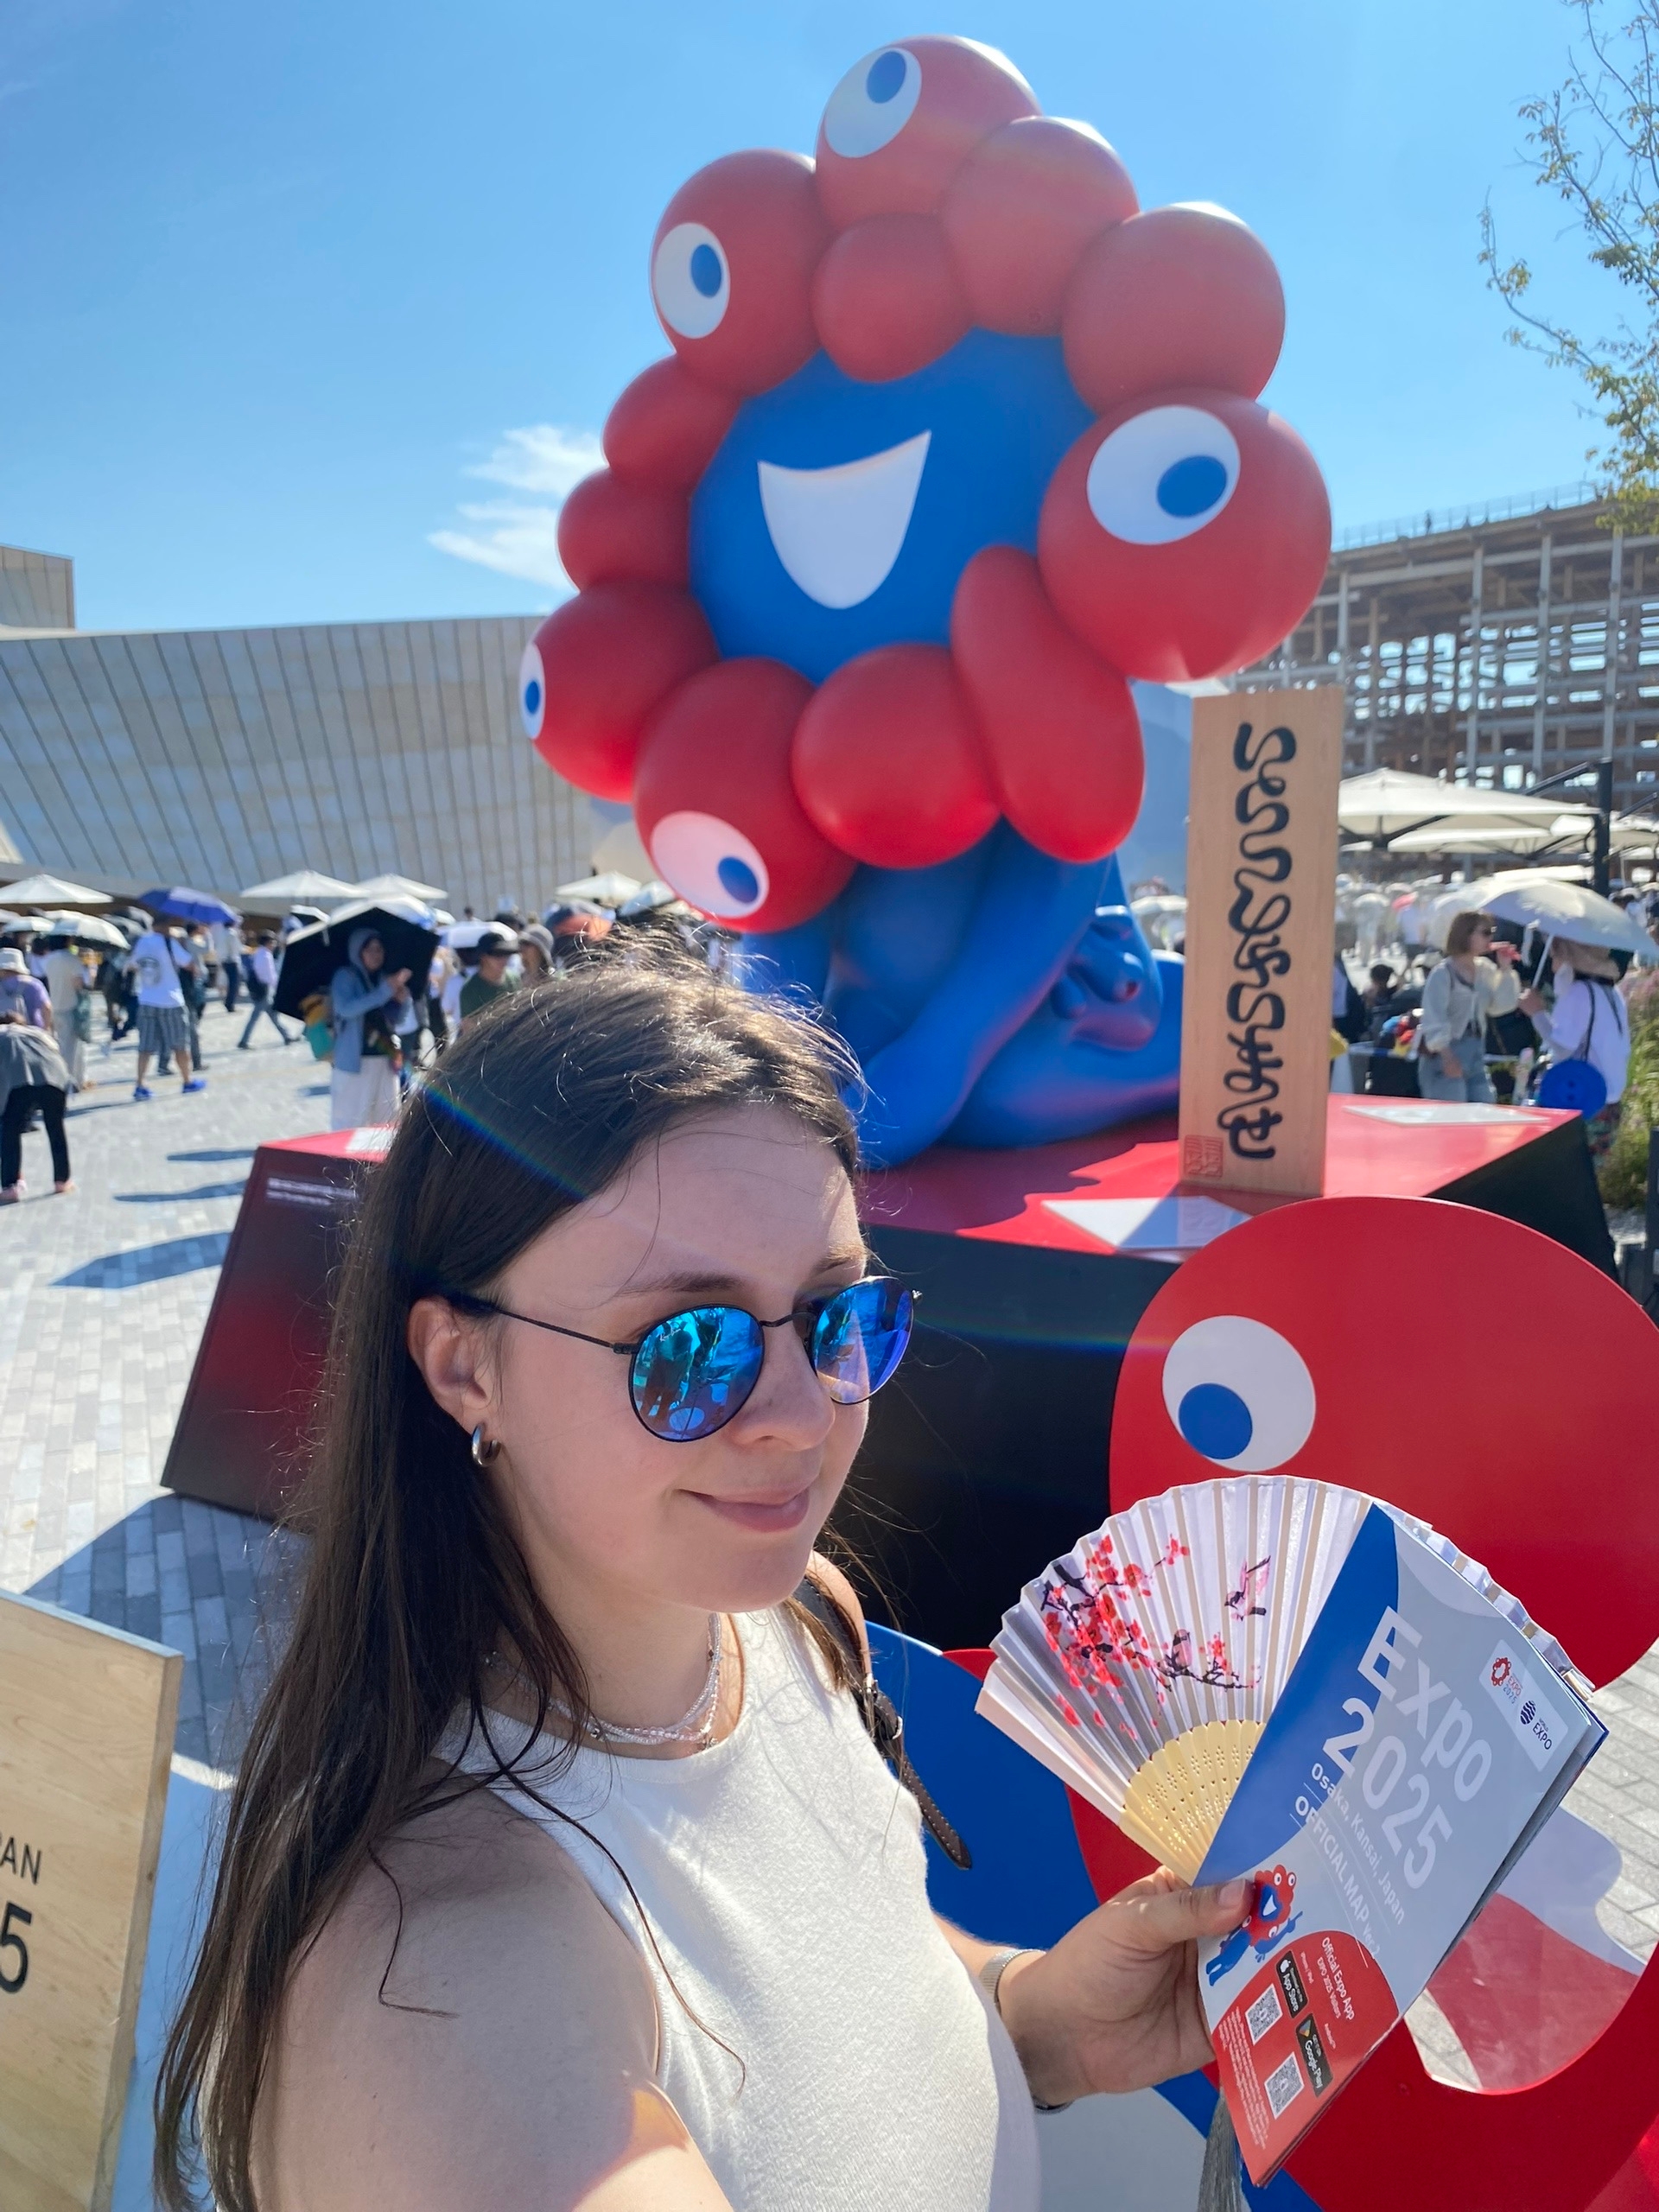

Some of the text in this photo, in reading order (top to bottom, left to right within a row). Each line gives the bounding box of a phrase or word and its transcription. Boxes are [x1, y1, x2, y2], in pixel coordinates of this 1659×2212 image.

[1357, 1605, 1492, 1802] Expo
[1503, 1684, 1518, 1704] 2025
[1508, 1675, 1522, 1696] EXPO
[1533, 1722, 1553, 1750] EXPO
[1322, 1698, 1453, 1890] 2025
[0, 1835, 41, 1886] AN
[1295, 1796, 1349, 1882] OFFICIAL
[1344, 1874, 1370, 1923] MAP
[1312, 1763, 1405, 1925] Osaka, Kansai, Japan
[1283, 1974, 1299, 2012] App Store
[1322, 1936, 1356, 2020] Official Expo App
[1305, 2040, 1324, 2088] Google Play
